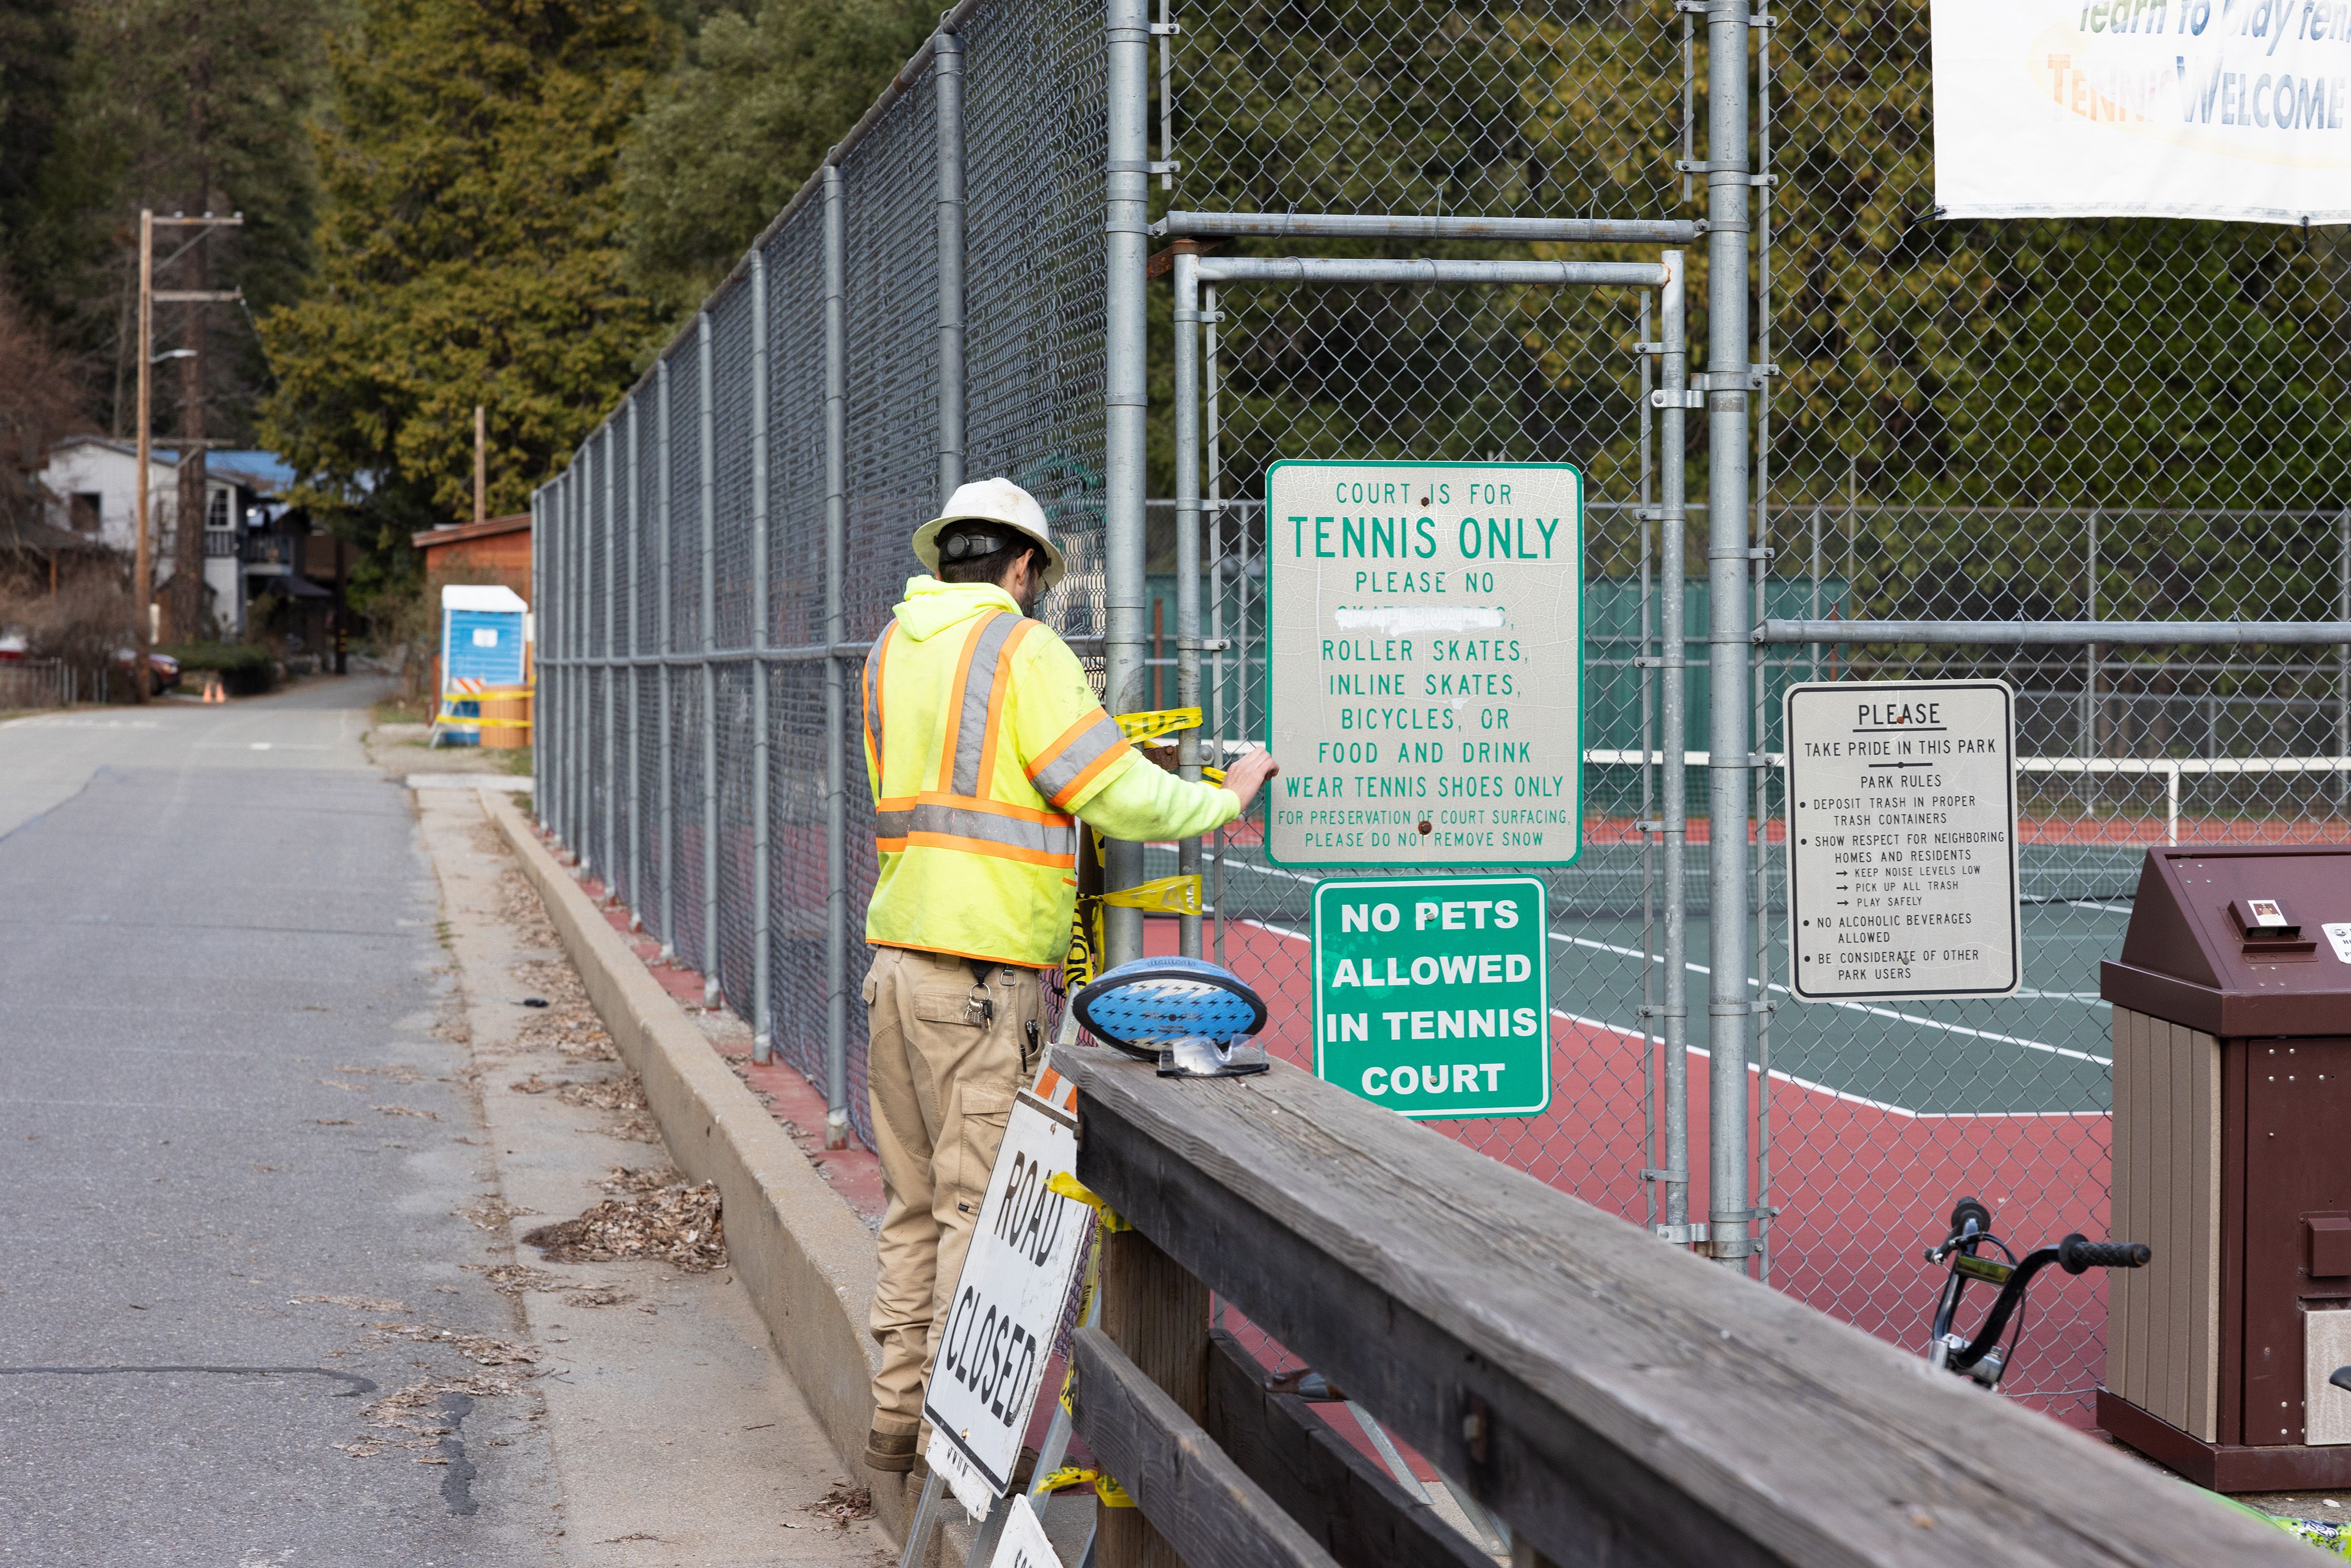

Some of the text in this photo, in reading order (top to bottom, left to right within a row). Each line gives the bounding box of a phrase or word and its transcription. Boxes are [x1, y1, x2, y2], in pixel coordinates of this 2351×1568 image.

[2079, 0, 2167, 33] learn
[2178, 0, 2211, 36] to
[2299, 0, 2351, 43] ten
[1336, 482, 1511, 505] COURT IS FOR
[1288, 516, 1559, 559] TENNIS ONLY
[1356, 571, 1494, 593] PLEASE NO
[1322, 639, 1412, 661] ROLLER
[1330, 674, 1405, 695] INLINE
[1481, 708, 1509, 730] OR
[1858, 703, 1940, 725] PLEASE
[1319, 742, 1531, 764] FOOD AND DRINK
[1804, 739, 1995, 757] TAKE PRIDE IN THIS PARK
[1285, 776, 1563, 798] WEAR TENNIS SHOES ONLY
[1861, 774, 1941, 789] PARK RULES
[1814, 795, 1975, 810] DEPOSIT TRASH IN PROPER
[1278, 810, 1303, 825] FOR
[1310, 810, 1411, 825] PRESERVATION
[1417, 809, 1434, 824] OF
[1441, 809, 1484, 825] COURT
[1834, 813, 1947, 826] TRASH CONTAINERS
[1305, 832, 1543, 847] PLEASE DO NOT REMOVE SNOW
[1815, 832, 2004, 847] SHOW RESPECT FOR NEIGHBORING
[1835, 849, 1971, 863] HOMES AND RESIDENTS
[1855, 865, 1980, 877] KEEP NOISE LEVELS LOW
[1856, 880, 1958, 892] PICK UP ALL TRASH
[1857, 896, 1922, 907] PLAY SAFELY
[1342, 900, 1519, 933] NO PETS
[1817, 913, 1971, 928] NO ALCOHOLIC BEVERAGES
[1838, 932, 1890, 943] ALLOWED
[1818, 949, 1978, 965] BE CONSIDERATE OF OTHER
[1332, 954, 1531, 987] ALLOWED
[1838, 967, 1911, 980] PARK USERS
[1327, 1008, 1537, 1042] IN TENNIS
[1362, 1063, 1505, 1095] COURT
[993, 1150, 1066, 1268] ROAD
[946, 1285, 1037, 1428] CLOSED
